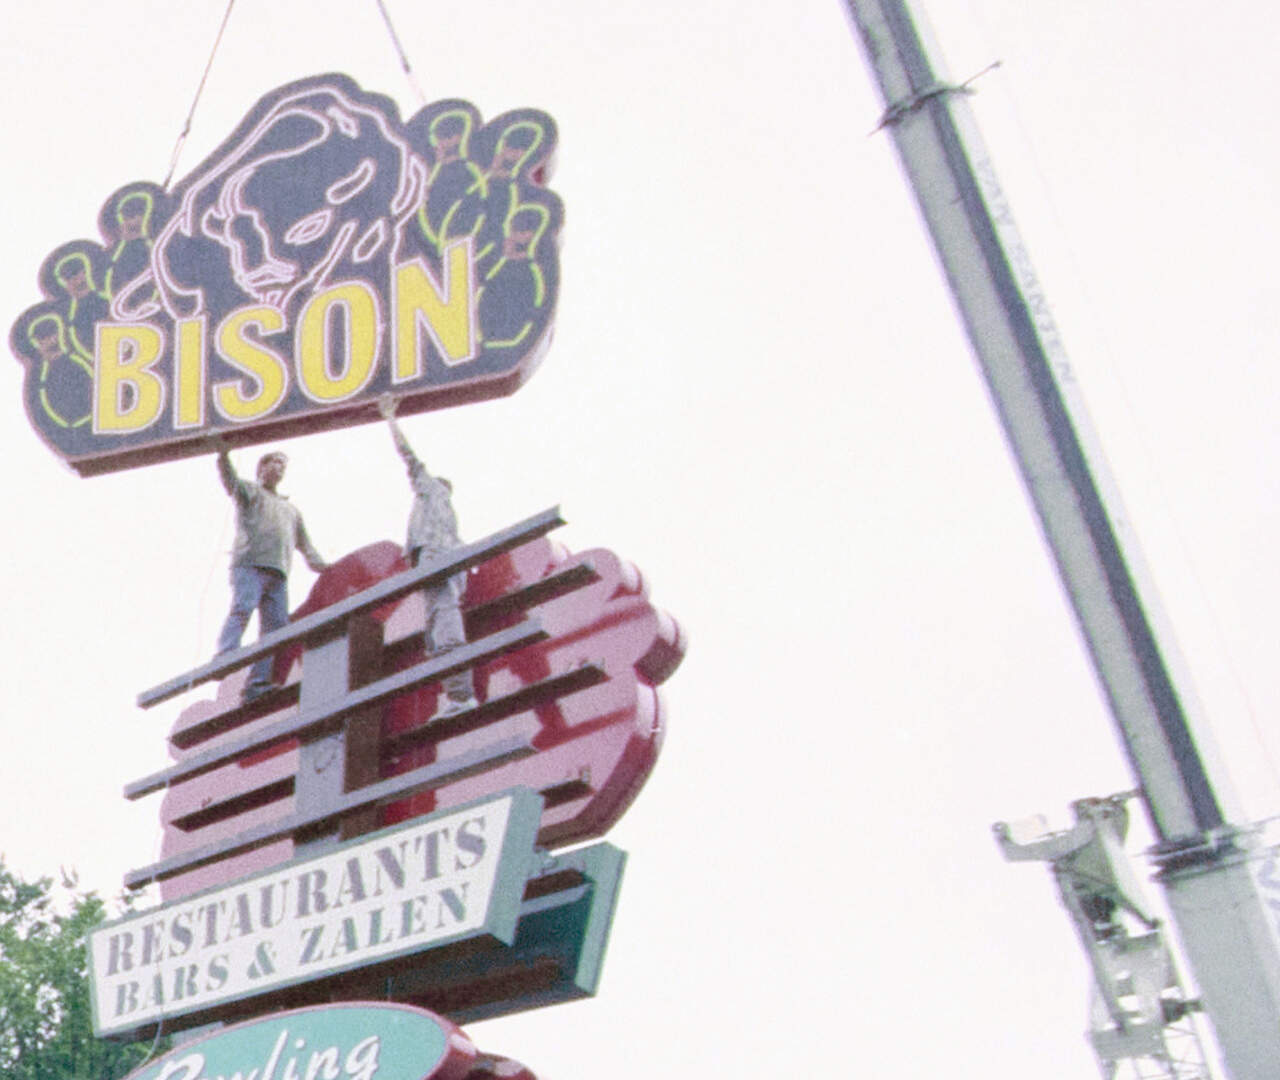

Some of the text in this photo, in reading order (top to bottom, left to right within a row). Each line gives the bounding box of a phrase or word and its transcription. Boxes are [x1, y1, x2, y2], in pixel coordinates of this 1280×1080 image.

[95, 238, 476, 434] BISON
[106, 815, 487, 976] RESTAURANTS
[114, 882, 471, 1018] BARS & ZALEN
